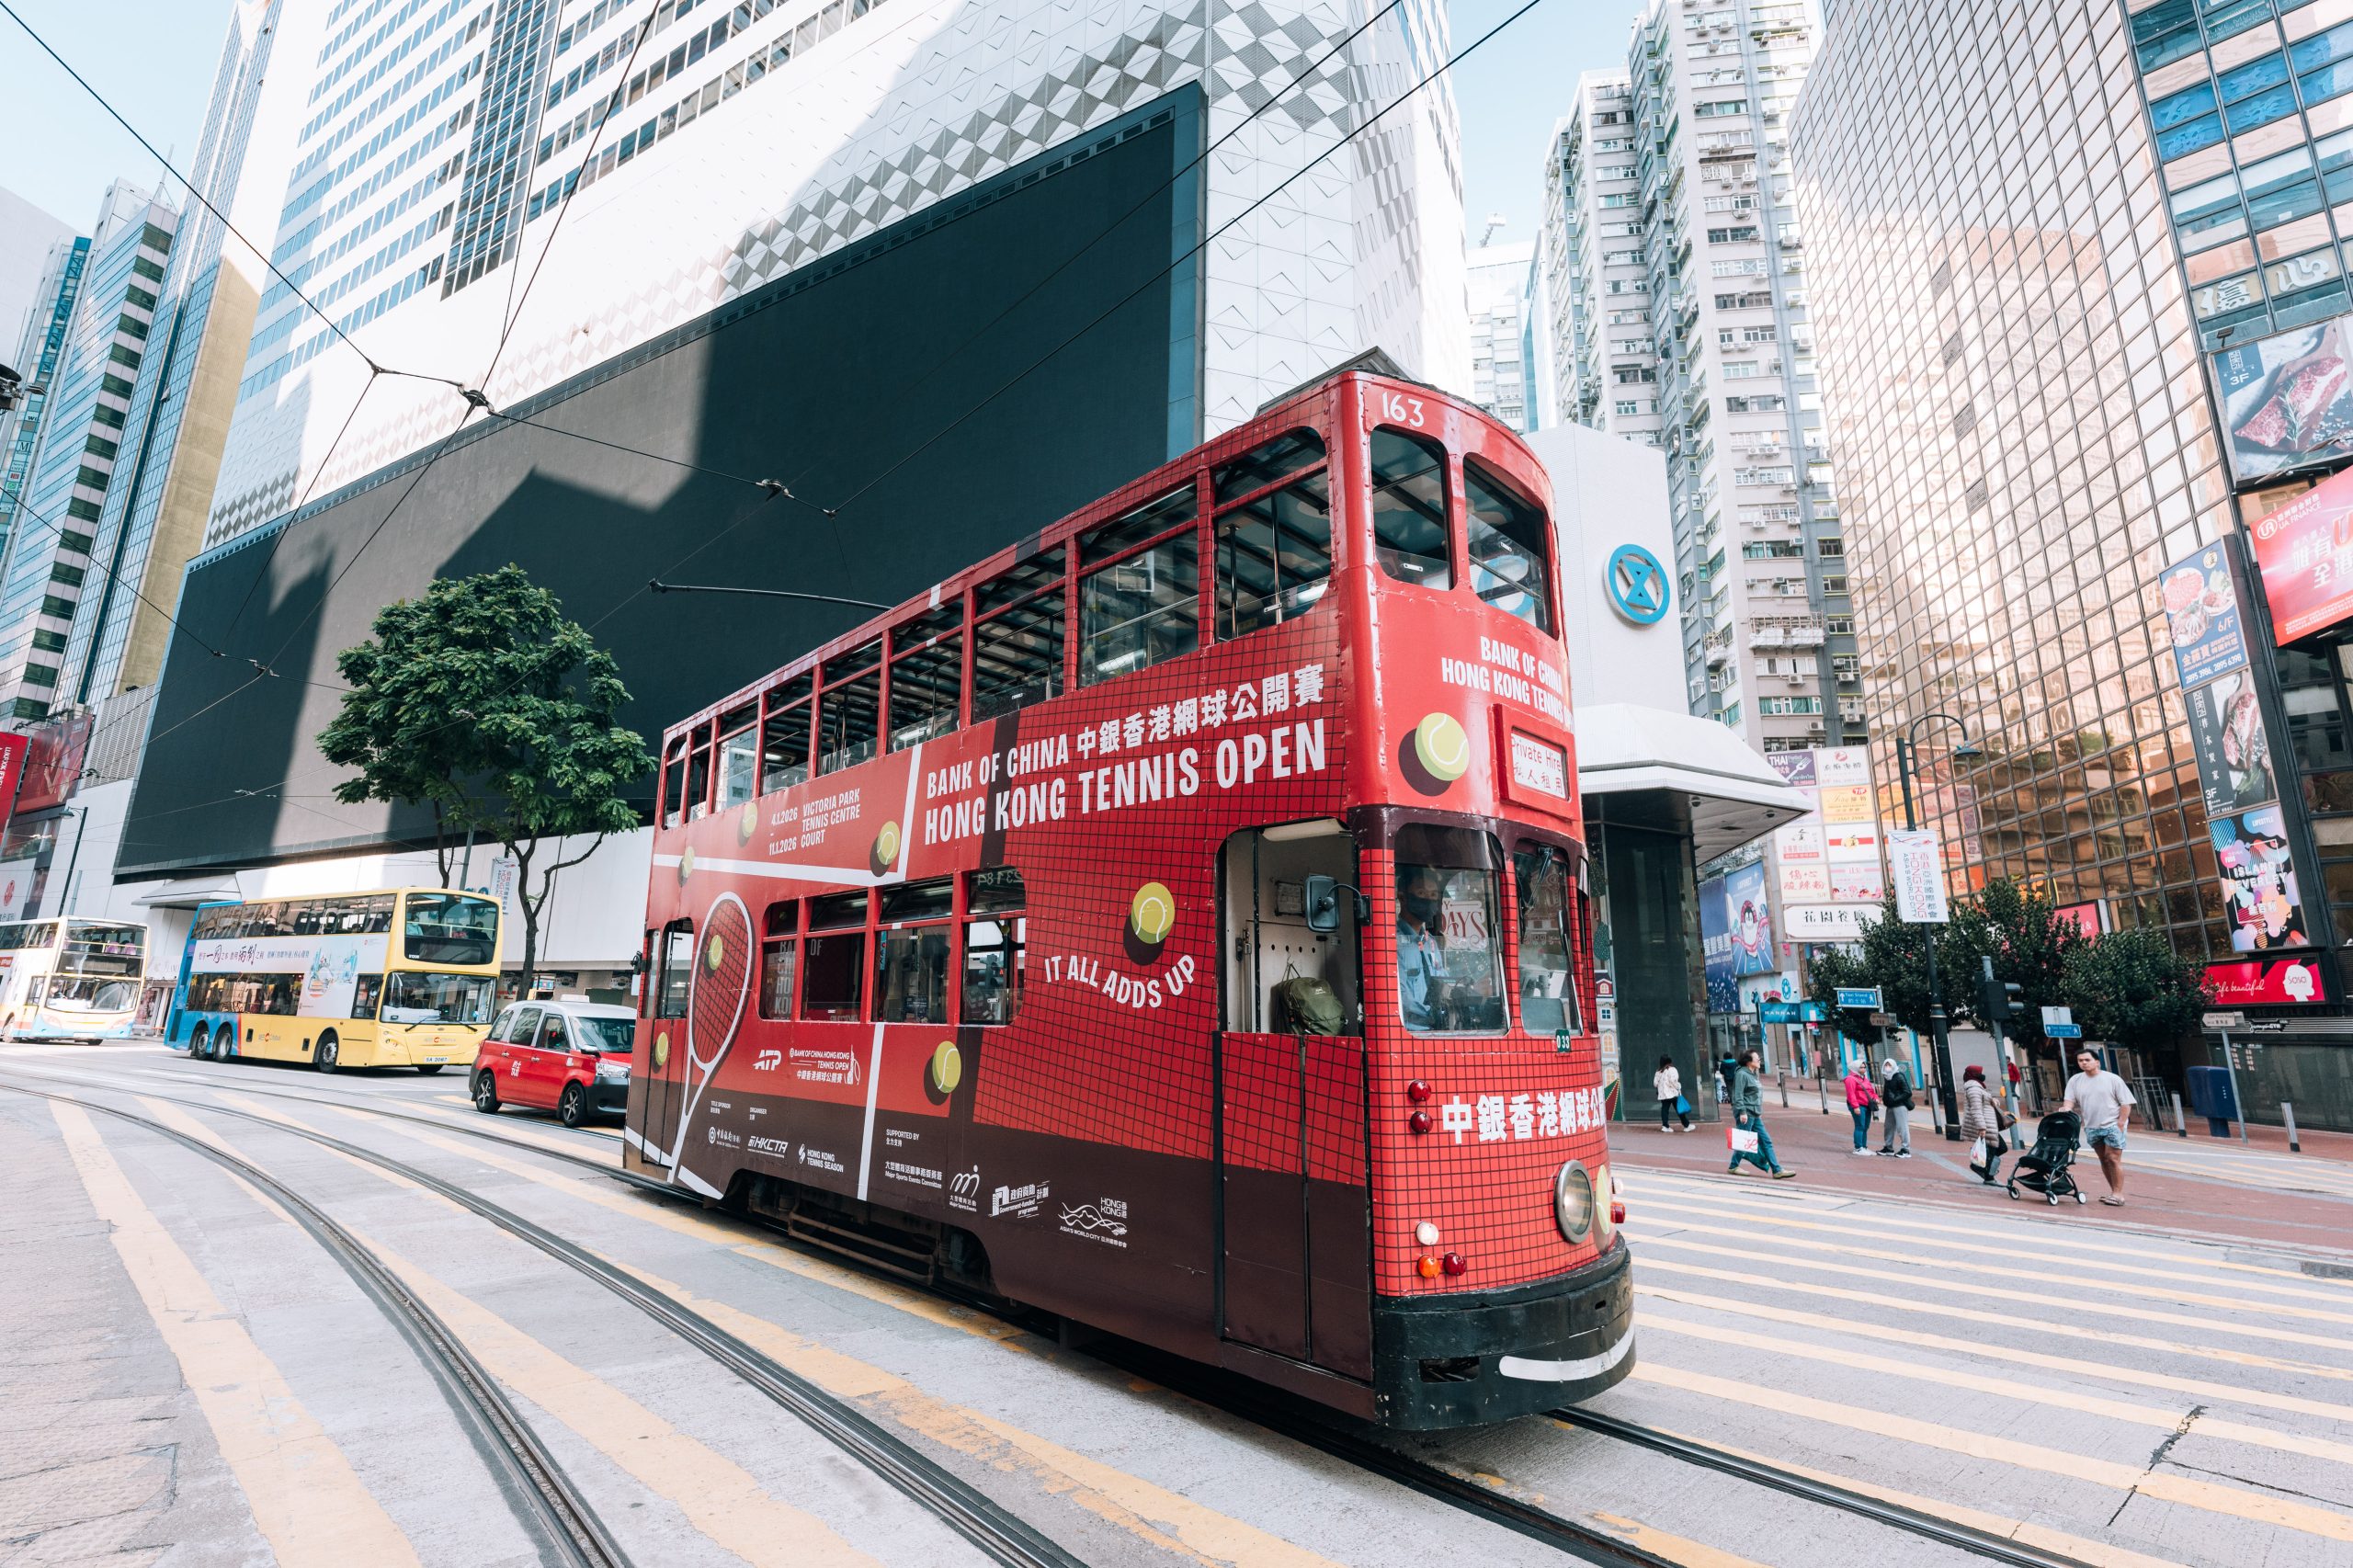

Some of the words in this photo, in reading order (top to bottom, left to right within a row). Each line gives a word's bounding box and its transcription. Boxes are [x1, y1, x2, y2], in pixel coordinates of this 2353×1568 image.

[2230, 373, 2250, 386] 3F
[1381, 392, 1424, 428] 163
[2279, 520, 2290, 530] UA
[2290, 503, 2323, 526] FINANCE
[2217, 617, 2234, 632] 6/F
[1480, 636, 1520, 672] BANK
[1523, 652, 1536, 679] OF
[1538, 659, 1563, 696] CHINA
[1441, 657, 1490, 692] HONG
[1493, 670, 1530, 705] KONG
[1531, 684, 1563, 723] TENNIS
[1077, 664, 1324, 760] 中銀香港網球公開賽
[1511, 736, 1542, 764] Private
[1546, 750, 1562, 772] Hire
[1769, 754, 1789, 766] THAI
[927, 760, 972, 799] BANK
[979, 753, 1000, 785] OF
[1006, 734, 1069, 778] CHINA
[924, 795, 985, 845] HONG
[995, 777, 1066, 831] KONG
[1078, 747, 1200, 814] TENNIS
[1216, 719, 1326, 789] OPEN
[1513, 761, 1563, 795] 私人租用
[803, 795, 836, 817] VICTORIA
[839, 788, 860, 808] PARK
[2205, 787, 2217, 799] 3F
[771, 807, 798, 827] 4.1.2026
[802, 814, 829, 832] TENNIS
[830, 804, 861, 825] CENTRE
[2252, 816, 2274, 827] LIFESTYLE
[769, 836, 796, 856] 11.1.2026
[801, 829, 825, 848] COURT
[1910, 853, 1922, 885] HONG
[2233, 862, 2277, 879] ISLAND
[2228, 873, 2287, 890] BEVERLEY
[1914, 886, 1927, 918] KONG
[1045, 955, 1061, 983] IT
[1067, 955, 1099, 988] ALL
[1102, 970, 1161, 1008] ADDS
[1165, 954, 1195, 996] UP
[2231, 979, 2265, 996] beautiful
[753, 1049, 782, 1071] ATP
[817, 1060, 834, 1069] TENNIS
[835, 1062, 849, 1070] OPEN
[886, 1129, 912, 1139] SUPPORTED
[807, 1148, 820, 1159] HONG
[821, 1151, 835, 1162] KONG
[807, 1157, 823, 1169] TENNIS
[824, 1160, 843, 1173] SEASON
[885, 1170, 895, 1179] Major
[896, 1173, 908, 1182] Sports
[909, 1176, 921, 1184] Events
[921, 1178, 942, 1189] Committee
[999, 1198, 1036, 1214] Government-funded
[1018, 1206, 1038, 1217] programme
[1101, 1197, 1122, 1208] HONG
[1101, 1206, 1122, 1218] KONG
[1074, 1230, 1089, 1238] WORLD
